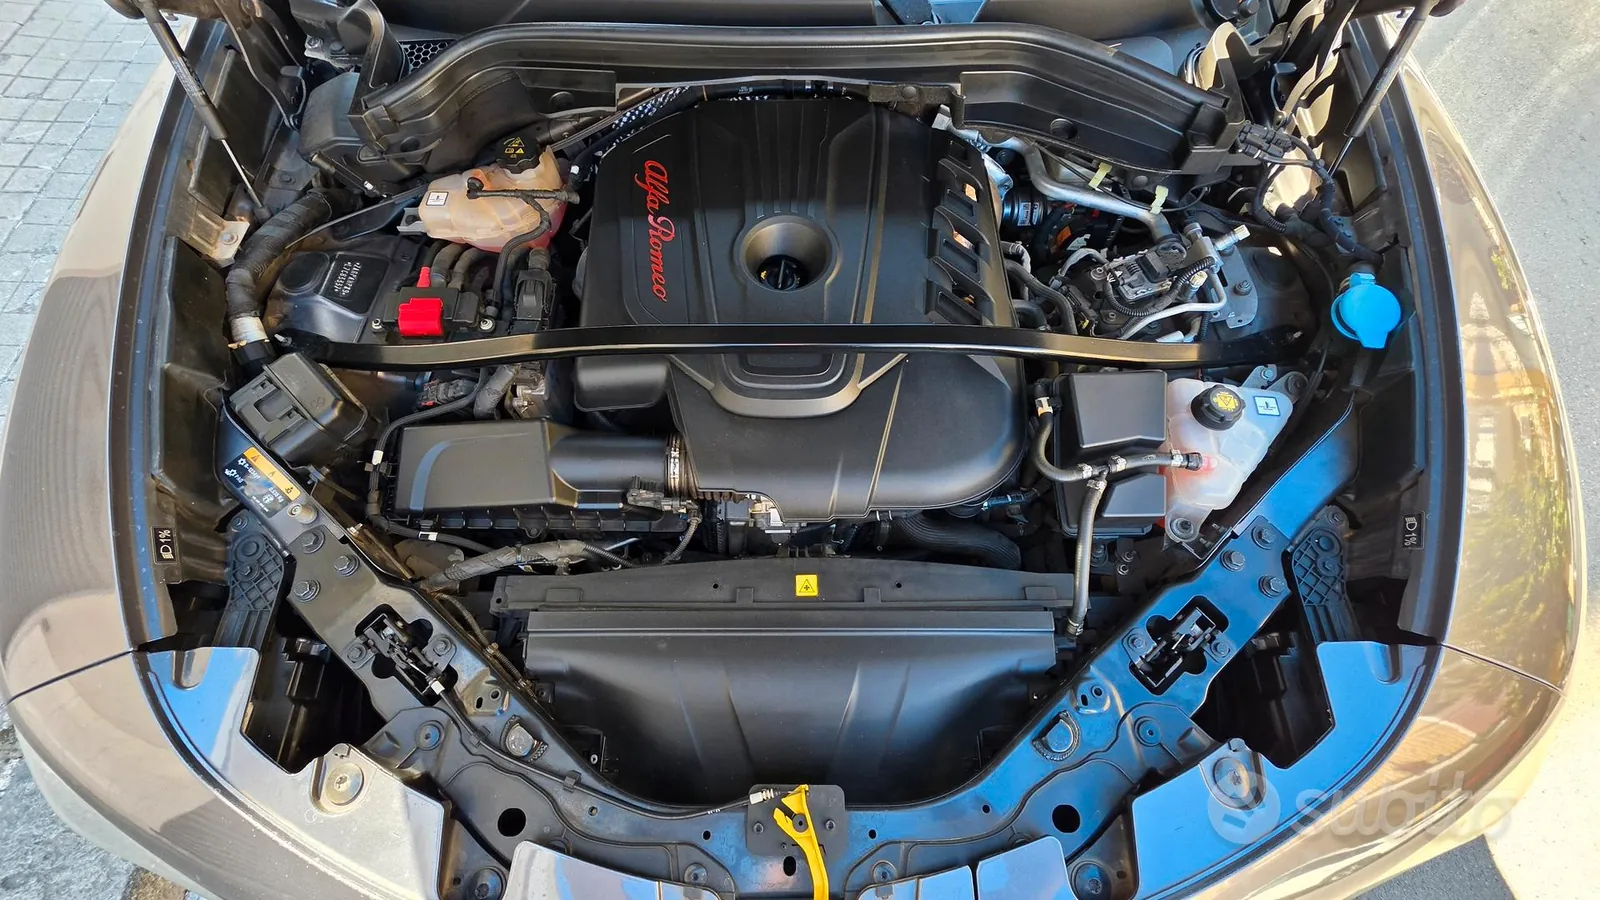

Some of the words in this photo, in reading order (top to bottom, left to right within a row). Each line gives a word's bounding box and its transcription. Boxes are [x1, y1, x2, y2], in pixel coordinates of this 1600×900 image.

[634, 160, 670, 214] Alfa
[648, 214, 675, 302] Romeo
[158, 529, 171, 543] 1%
[1404, 532, 1417, 546] 1%
